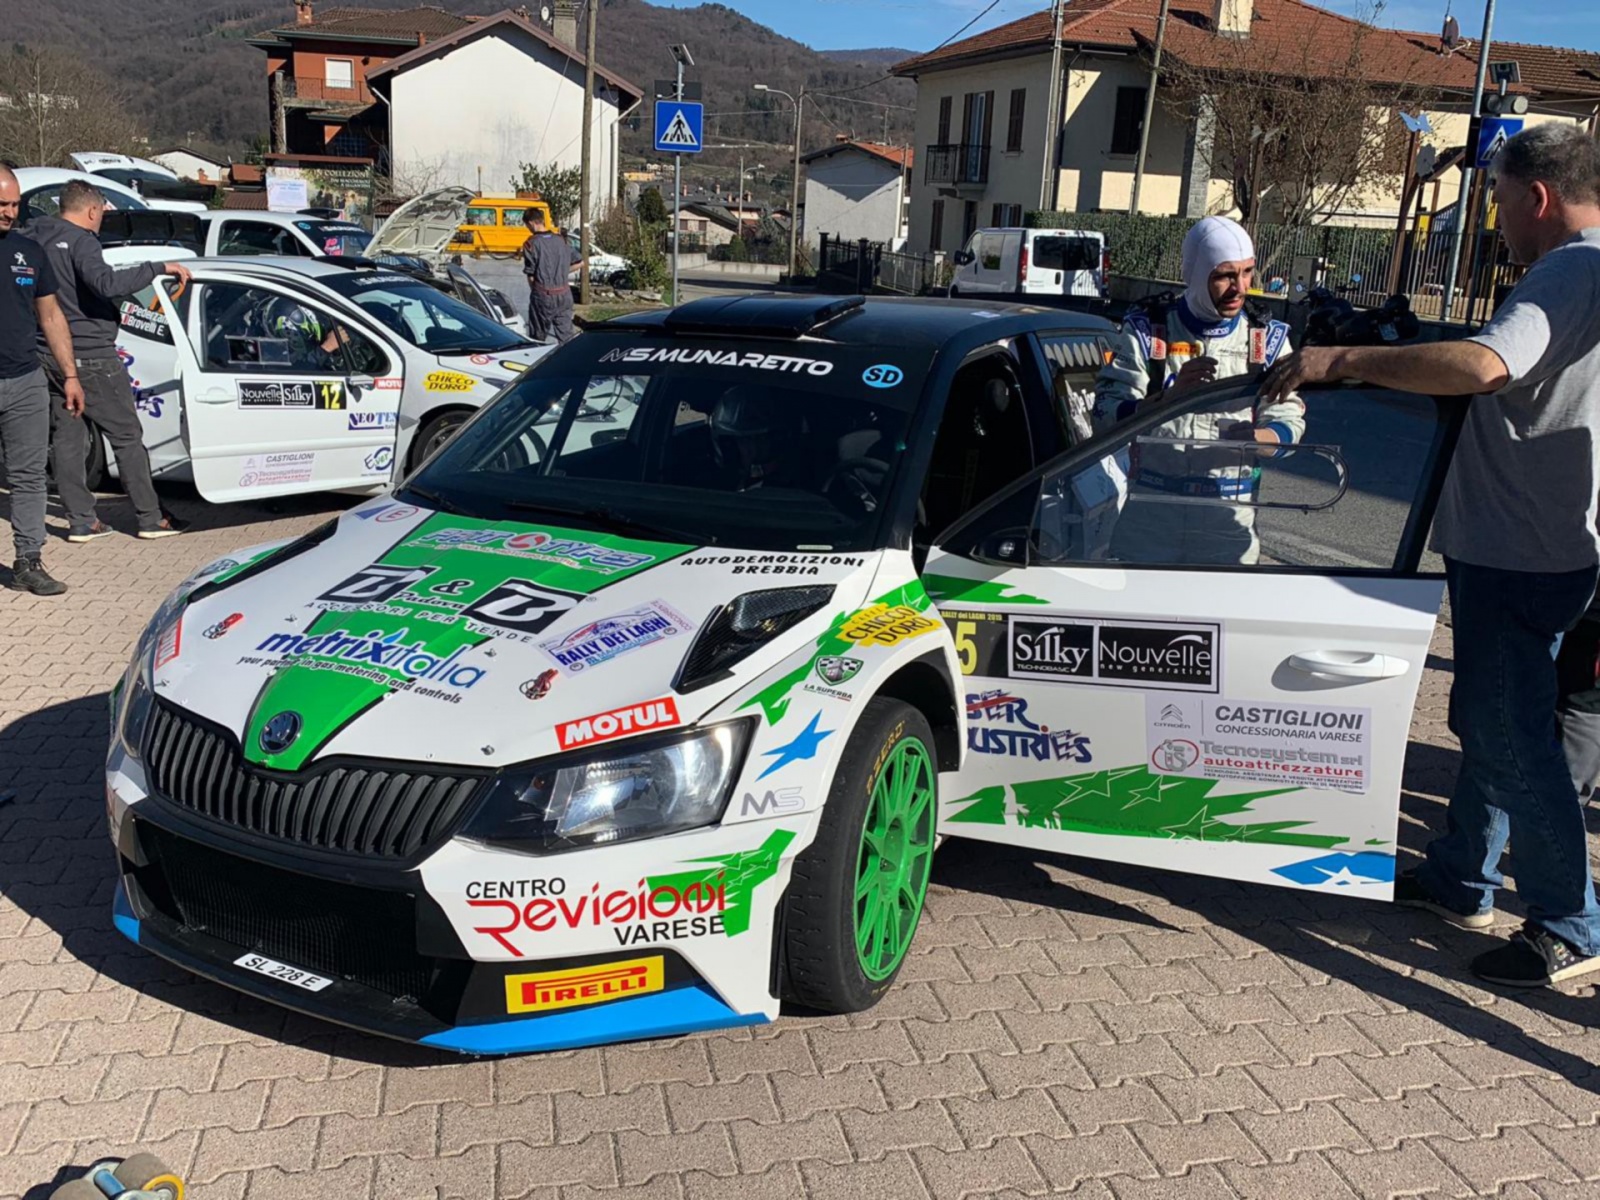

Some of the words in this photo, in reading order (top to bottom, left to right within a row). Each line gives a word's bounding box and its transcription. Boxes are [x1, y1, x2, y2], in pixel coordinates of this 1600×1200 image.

[15, 276, 34, 286] cpm
[427, 373, 475, 385] CHICCO
[865, 368, 899, 384] SD
[240, 385, 282, 399] Nouvelle
[283, 385, 312, 406] Silky
[321, 384, 341, 409] 12
[265, 453, 315, 463] CASTIGLIONI
[681, 554, 866, 567] AUTODEMOLIZIONI
[731, 565, 820, 576] BREBBIA
[430, 579, 473, 596] &
[392, 591, 466, 610] Padova
[417, 610, 460, 625] PER
[466, 621, 533, 644] TENDE
[845, 607, 916, 640] CHICCO
[941, 610, 958, 618] RALLY
[968, 612, 986, 620] LAGHI
[556, 640, 602, 666] RALLY
[600, 630, 630, 648] DEI
[624, 615, 672, 639] LAGHI
[873, 616, 934, 643] D'ORO
[954, 621, 978, 676] 5
[1014, 627, 1090, 673] Silky
[1100, 634, 1211, 669] Nouvelle
[237, 656, 263, 666] your
[313, 661, 334, 671] gas
[334, 662, 387, 684] metering
[388, 677, 415, 692] and
[414, 685, 463, 705] controls
[1100, 662, 1124, 672] new
[1132, 665, 1211, 677] generation
[816, 686, 853, 699] SUPERBA
[564, 701, 674, 746] MOTUL
[1215, 705, 1363, 730] CASTIGLIONI
[1215, 724, 1317, 740] CONCESSIONARIA
[1318, 731, 1363, 743] VARESE
[1200, 740, 1339, 765] Tecnosystem
[1340, 756, 1363, 766] srl
[1203, 757, 1364, 778] autoattrezzature
[740, 786, 806, 816] MS
[465, 877, 567, 900] CENTRO
[613, 915, 726, 946] VARESE
[244, 957, 269, 972] SL
[267, 965, 305, 982] 228
[300, 975, 321, 988] E
[521, 965, 649, 1006] PIRELLI
